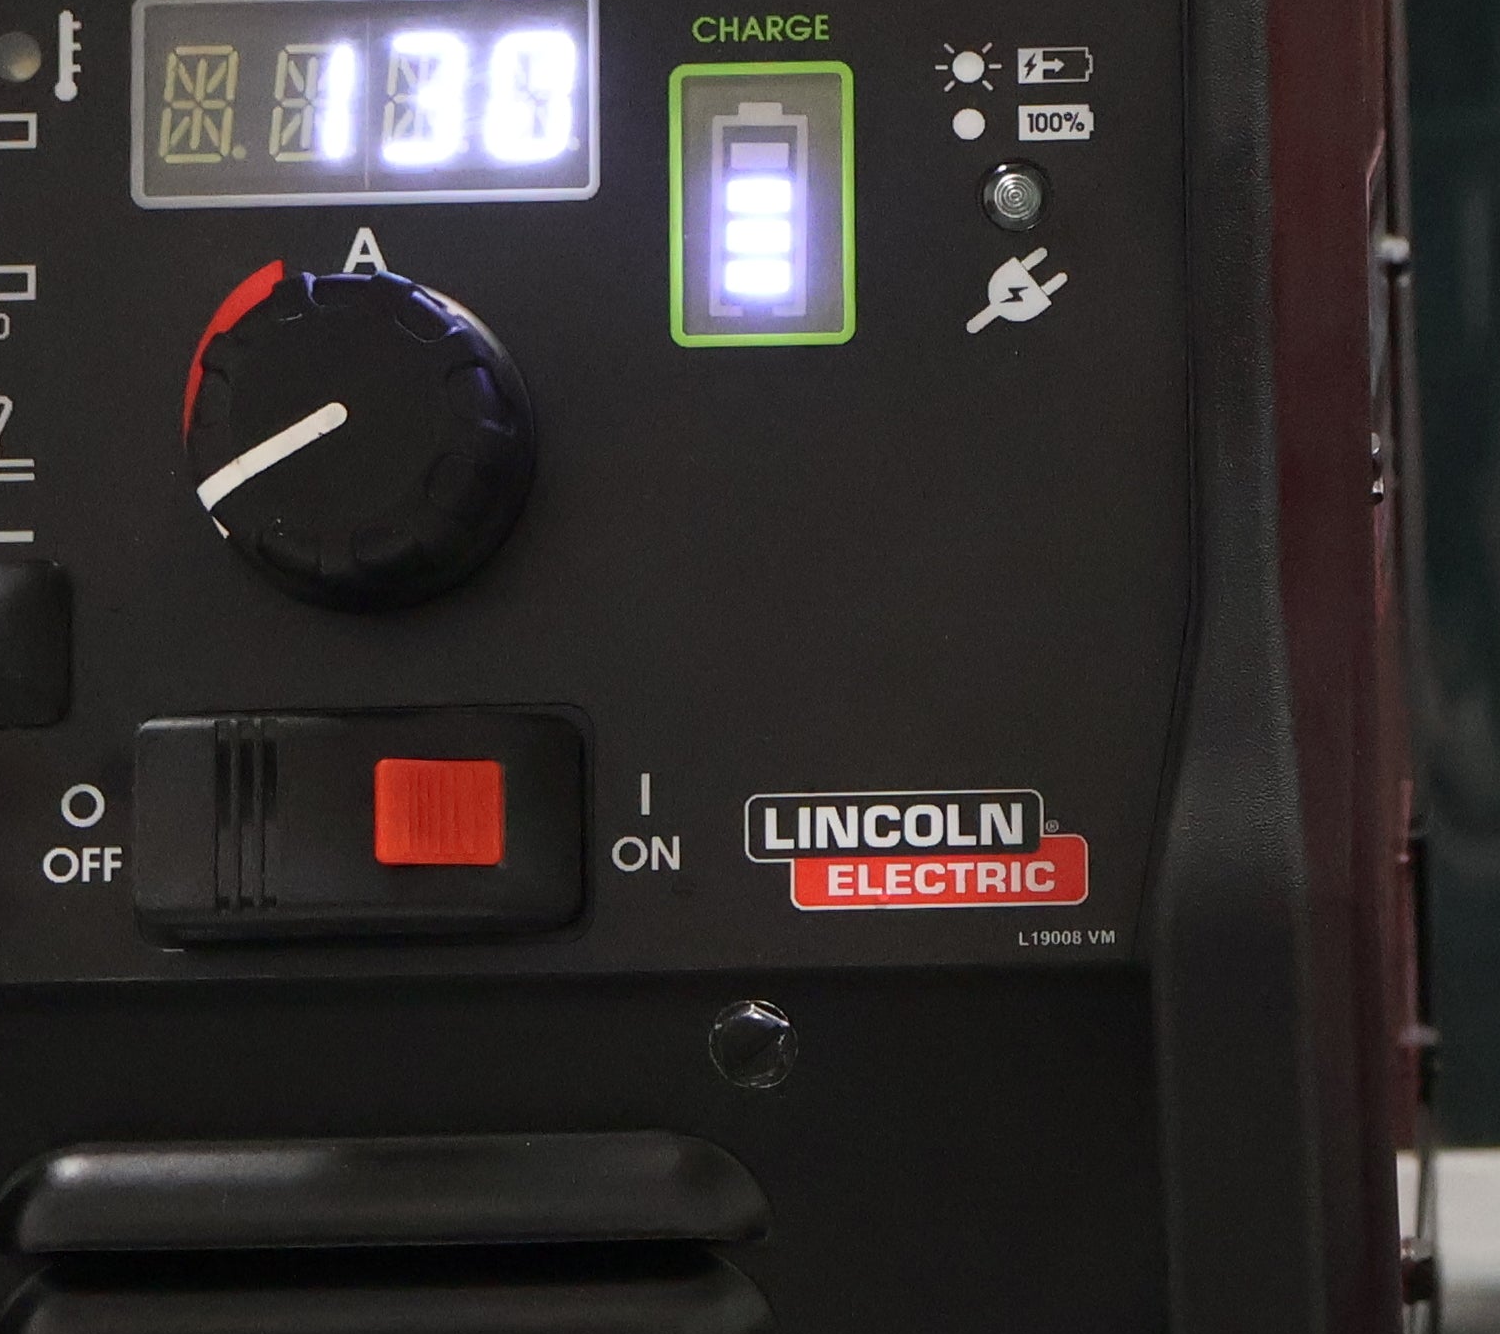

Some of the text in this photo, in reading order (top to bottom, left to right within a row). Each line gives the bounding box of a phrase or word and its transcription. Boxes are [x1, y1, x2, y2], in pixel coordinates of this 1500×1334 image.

[692, 14, 830, 43] CHARGE
[1026, 111, 1086, 134] 100%
[343, 226, 388, 273] A
[764, 803, 1024, 851] LINCOLN
[42, 846, 123, 884] OFF
[611, 835, 681, 872] ON
[827, 860, 1056, 897] ELECTRIC
[1018, 929, 1116, 947] L19008 VM
